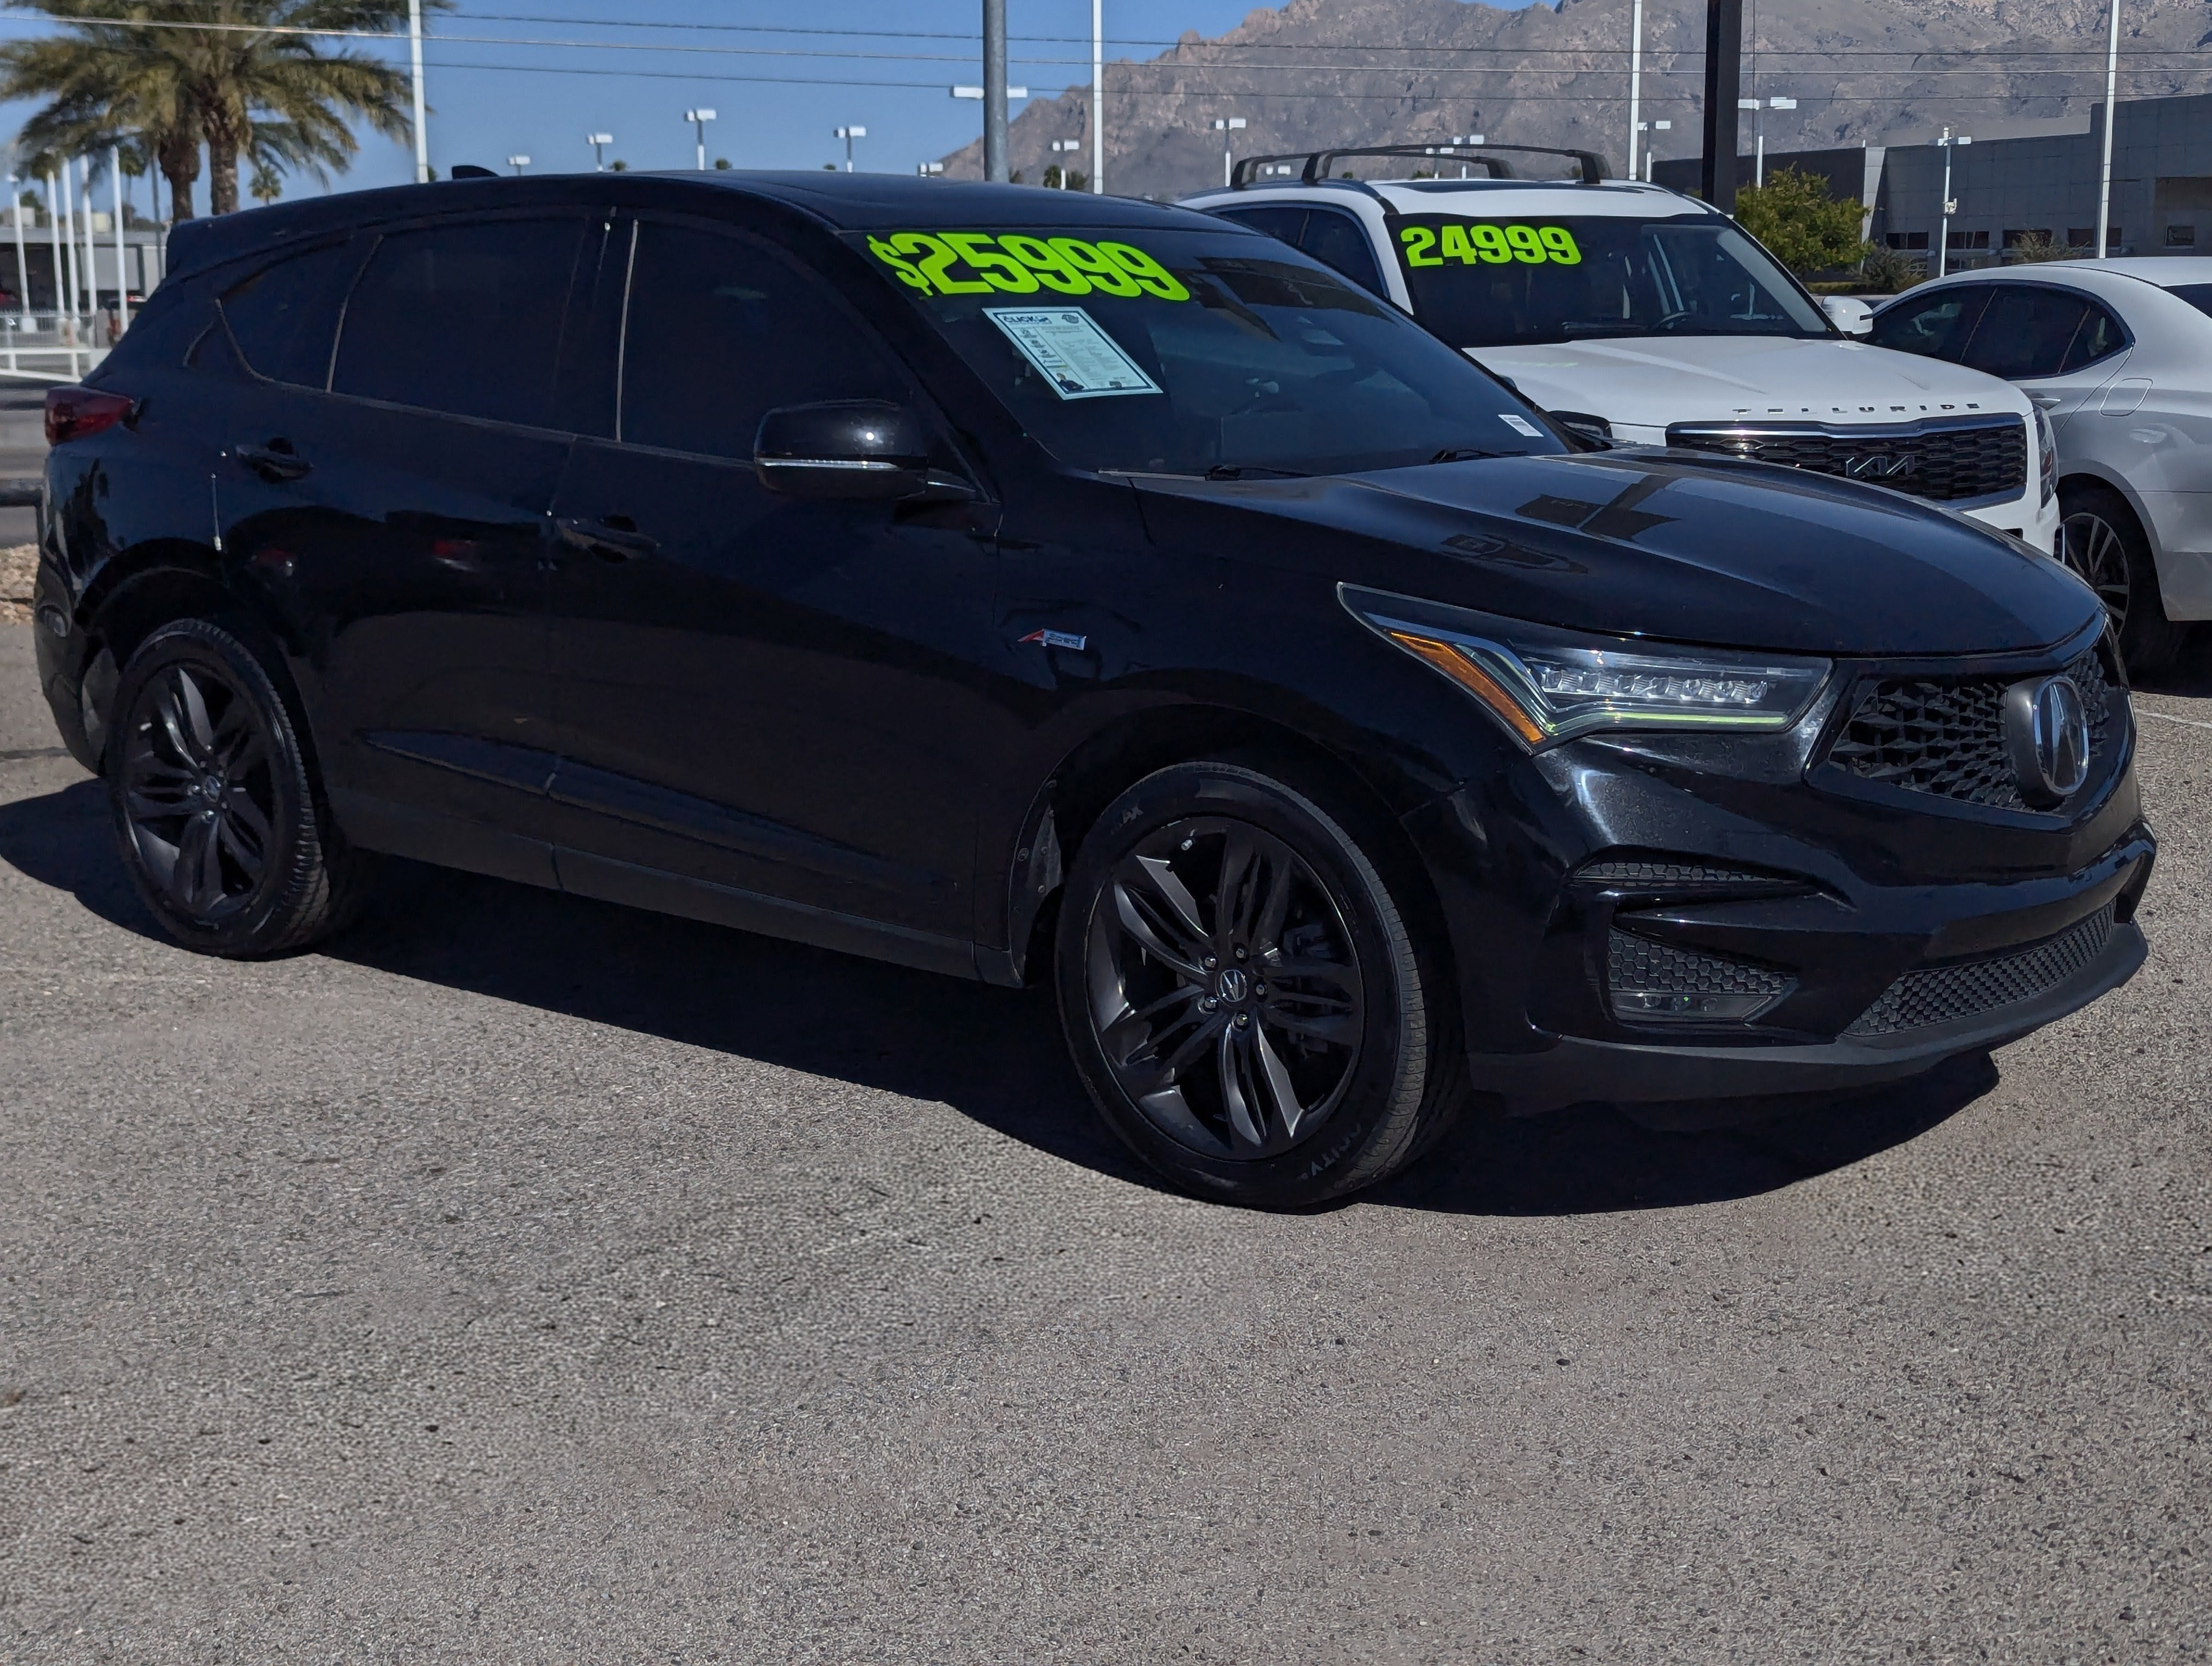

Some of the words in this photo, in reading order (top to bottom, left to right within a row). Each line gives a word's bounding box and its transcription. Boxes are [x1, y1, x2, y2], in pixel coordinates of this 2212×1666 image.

[867, 233, 1190, 301] $25999
[1400, 225, 1581, 267] 24999
[1732, 403, 1980, 414] TELLURIDE
